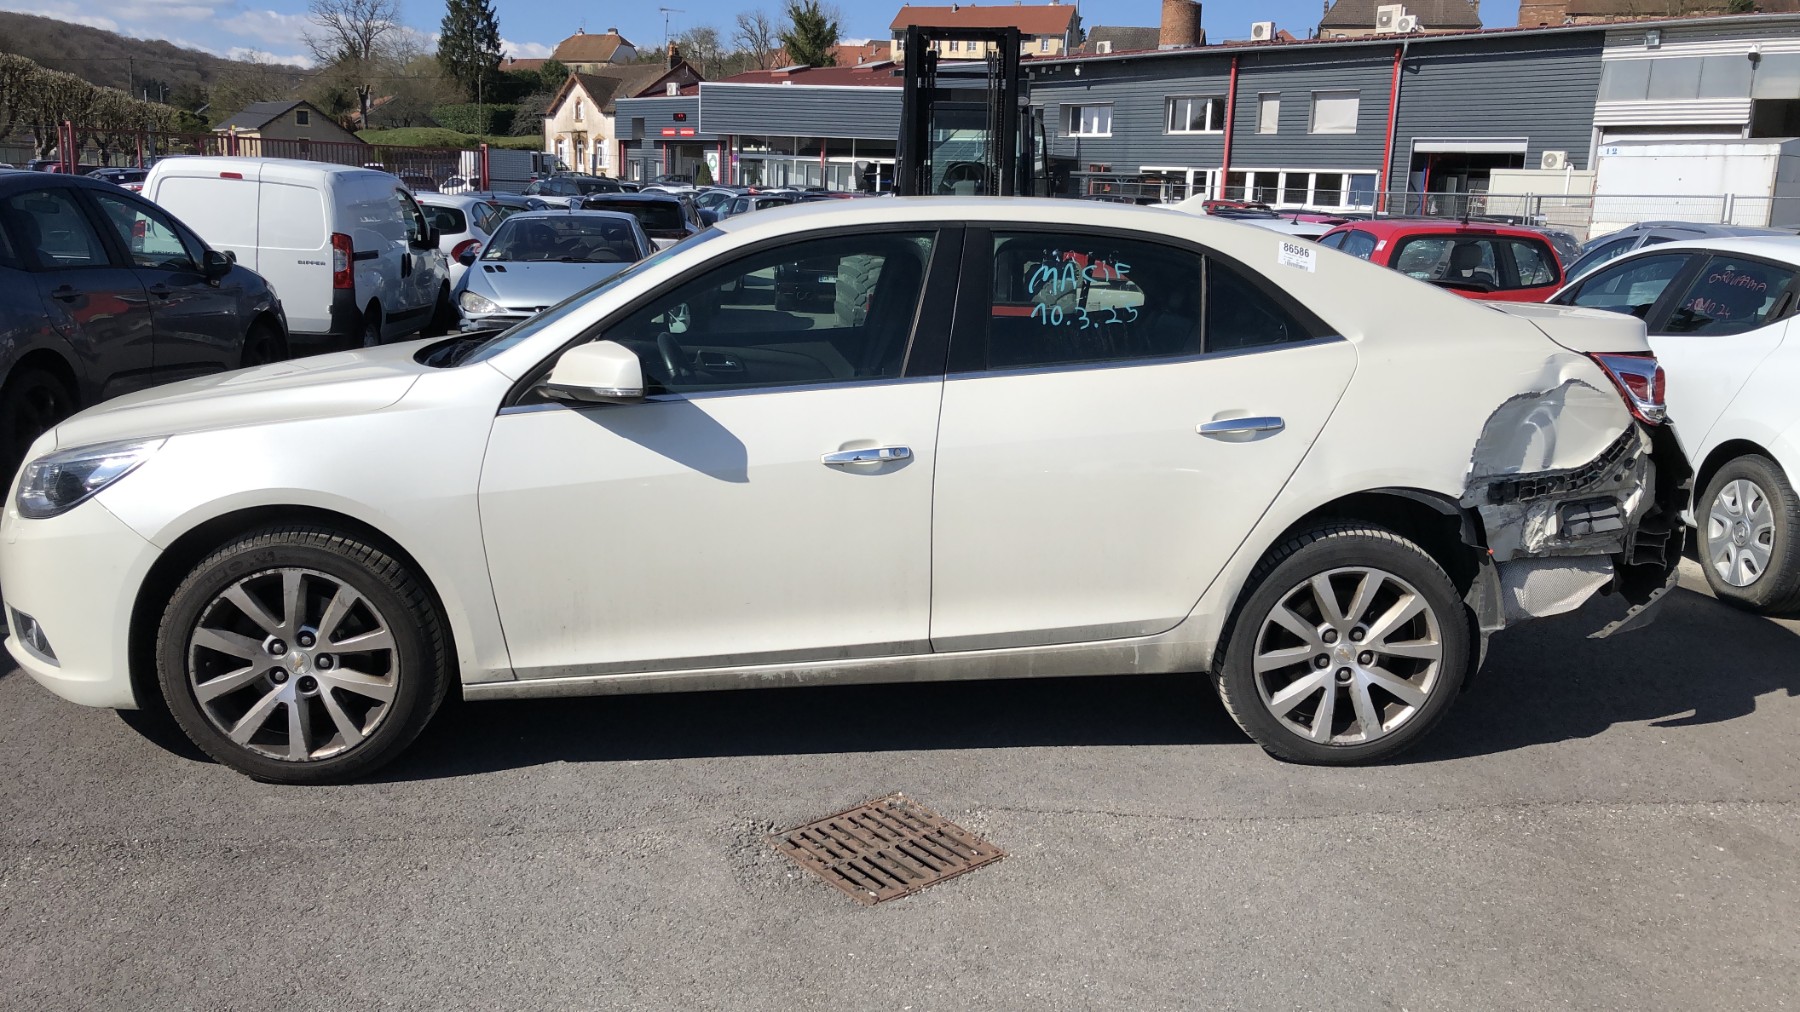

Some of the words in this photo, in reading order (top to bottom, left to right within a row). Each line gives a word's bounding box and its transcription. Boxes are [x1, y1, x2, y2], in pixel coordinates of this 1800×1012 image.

[1283, 242, 1310, 258] 86586
[1028, 262, 1131, 296] MACIF
[1030, 303, 1138, 330] 10.3.25
